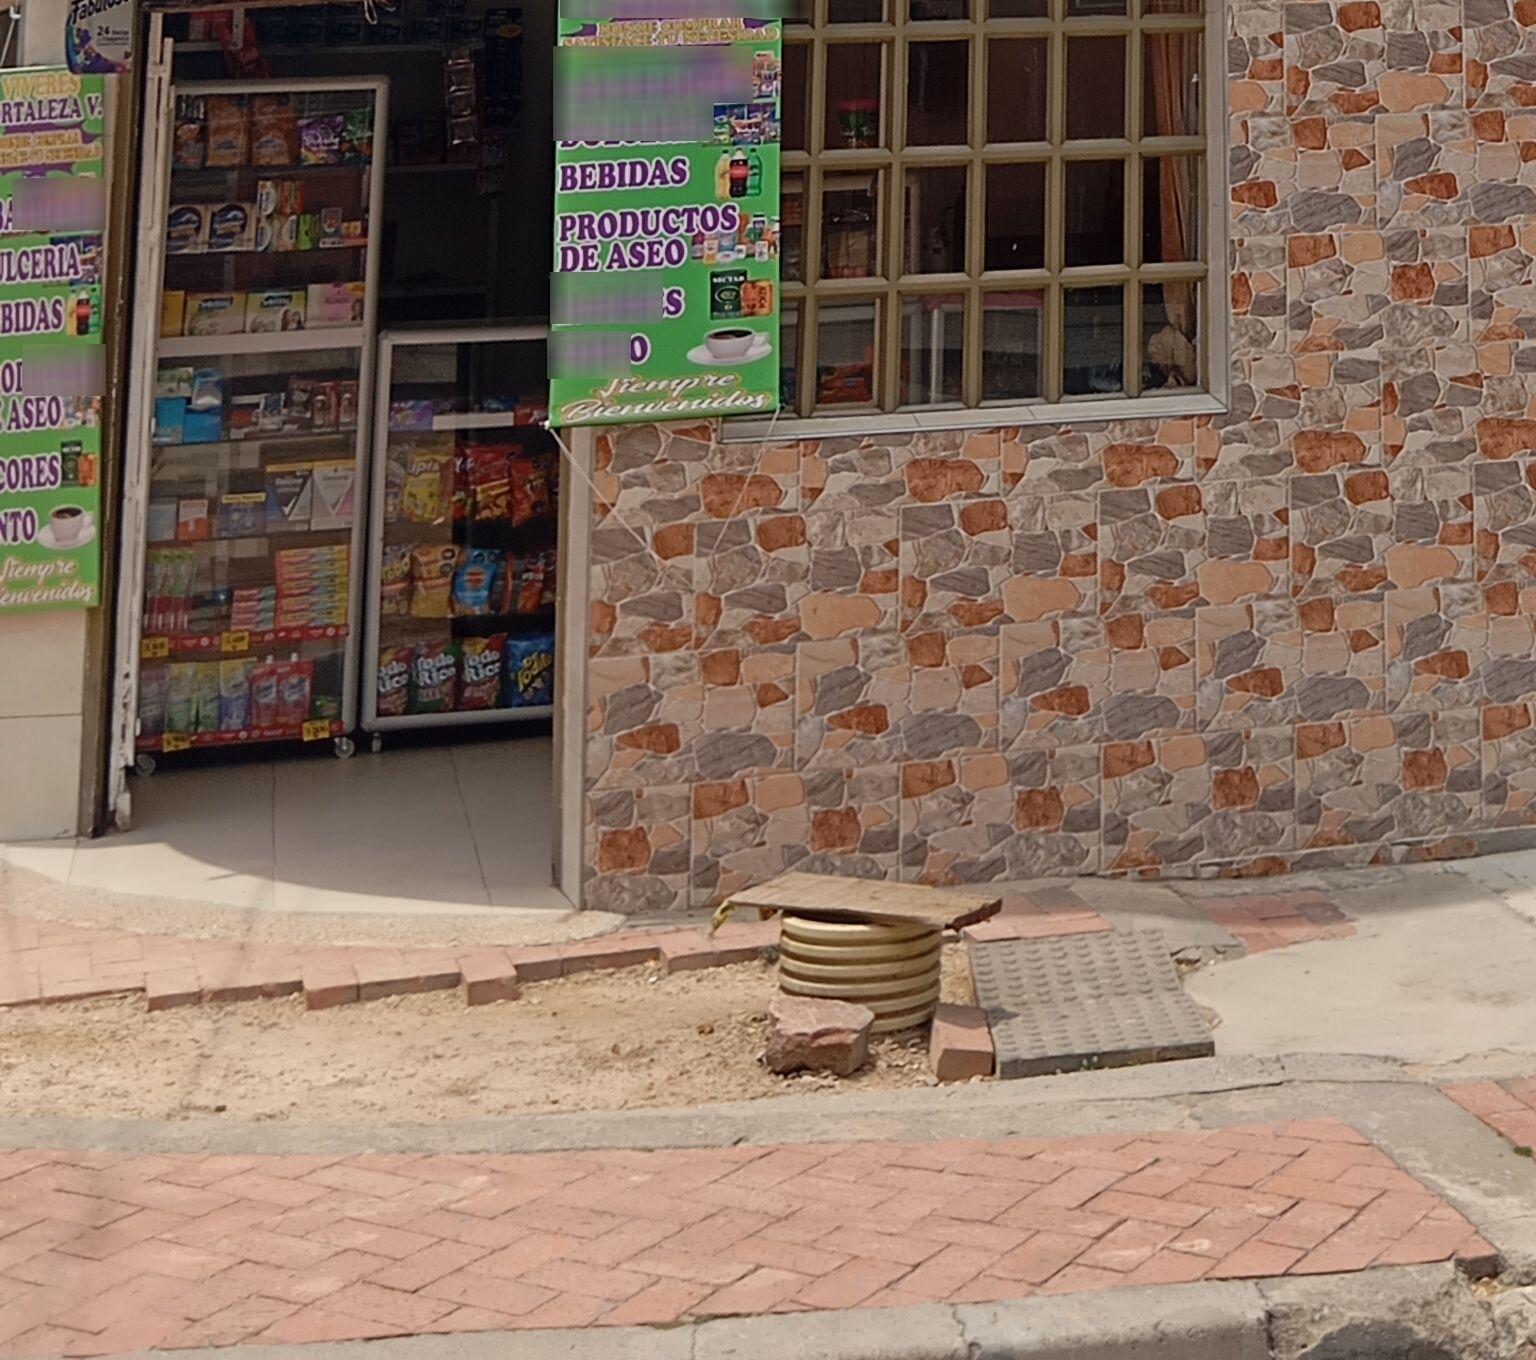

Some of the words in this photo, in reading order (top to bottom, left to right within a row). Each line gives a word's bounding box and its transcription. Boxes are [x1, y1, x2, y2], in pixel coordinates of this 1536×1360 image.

[4, 75, 80, 97] VIVERES
[559, 158, 688, 192] BEBIDAS
[559, 204, 738, 242] PRODUCTOS
[0, 245, 80, 281] LCERIA
[560, 244, 600, 272] DE
[606, 239, 686, 270] ASEO
[598, 373, 736, 398] Siempre
[7, 396, 62, 431] ASEO
[562, 391, 767, 422] Bienvenidos
